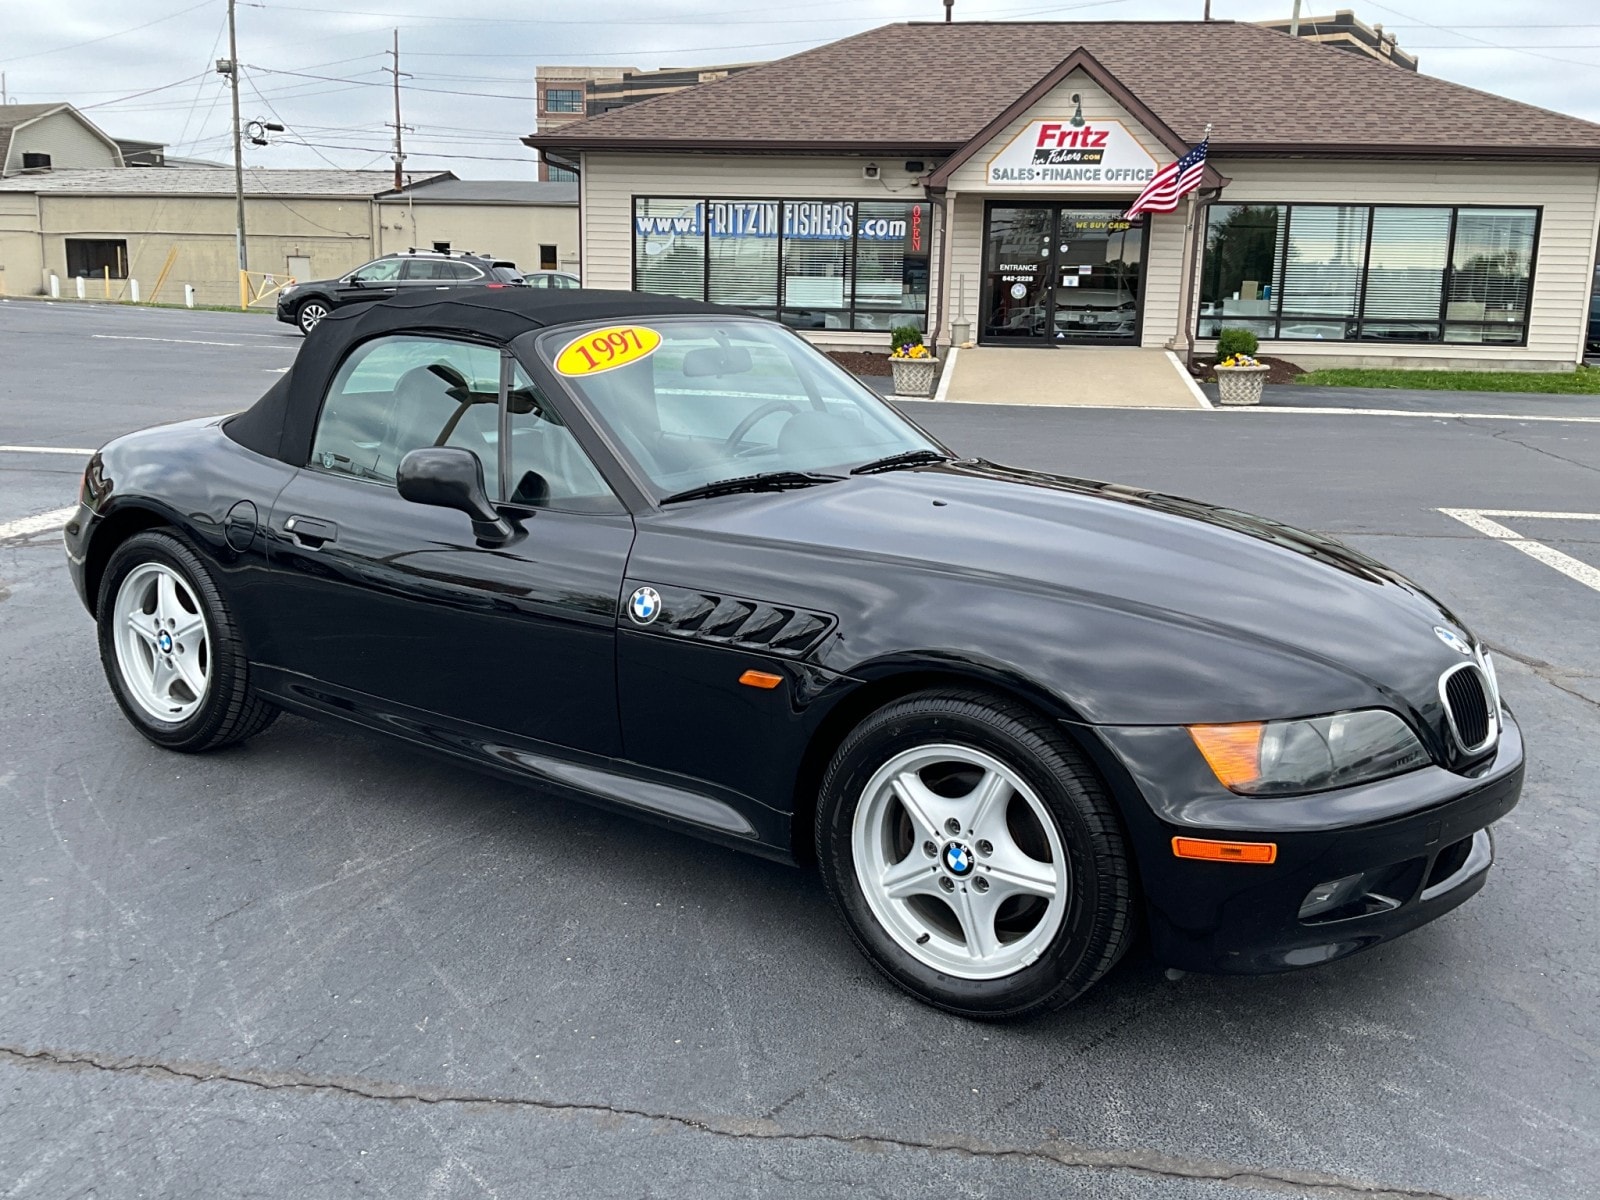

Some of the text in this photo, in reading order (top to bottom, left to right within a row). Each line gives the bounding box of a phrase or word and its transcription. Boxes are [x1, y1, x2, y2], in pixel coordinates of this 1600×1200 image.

[1036, 124, 1110, 148] Fritz
[1104, 168, 1153, 181] OFFICE
[912, 204, 921, 252] OPEN
[1075, 221, 1130, 229] WE BUY CARS
[575, 328, 643, 370] 1997
[949, 842, 974, 863] BMW
